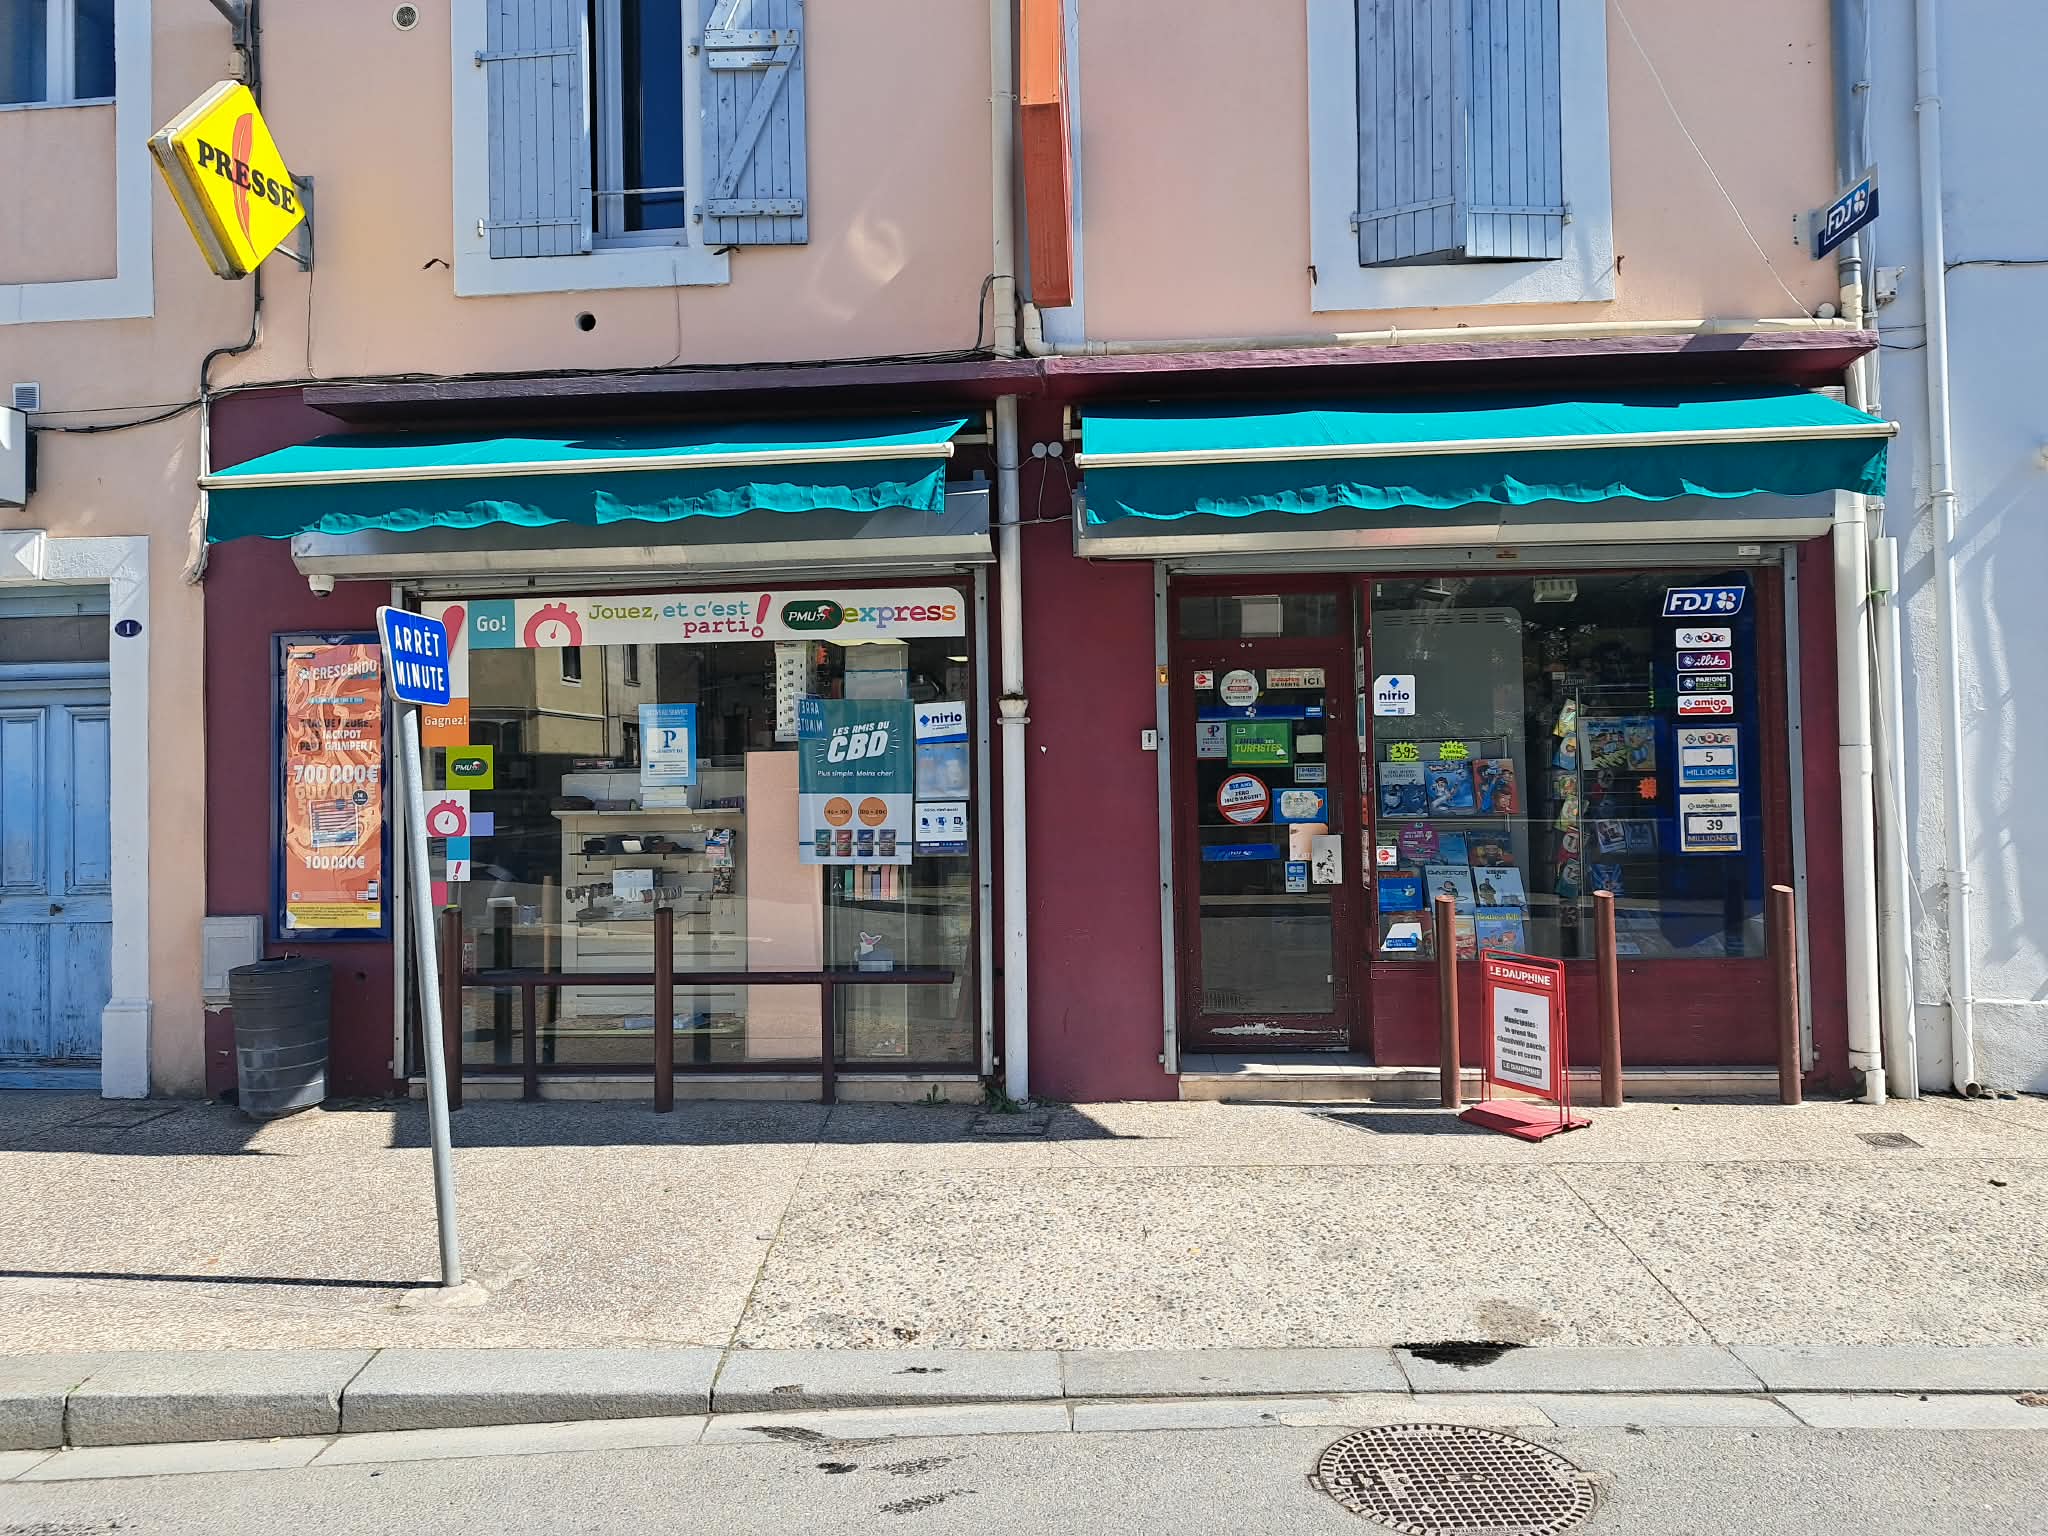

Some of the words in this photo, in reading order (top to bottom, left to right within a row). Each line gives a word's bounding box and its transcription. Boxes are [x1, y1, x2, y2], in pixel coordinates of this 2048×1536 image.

[197, 138, 296, 215] PRESSE
[1828, 198, 1853, 235] FDJ
[1669, 593, 1714, 611] FDJ
[588, 604, 659, 622] Jouez,
[663, 602, 689, 618] et
[694, 601, 751, 617] c'est
[788, 611, 816, 622] PMU
[844, 604, 957, 629] express
[126, 622, 131, 635] 1
[476, 615, 508, 632] Go!
[394, 625, 440, 658] ARRÊT
[1695, 632, 1726, 643] LOTO
[1694, 654, 1727, 667] illiko
[312, 660, 378, 681] CRESCENDO
[395, 659, 445, 692] MINUTE
[1303, 677, 1320, 686] ICI
[1379, 690, 1410, 701] nirio
[1694, 696, 1728, 711] amigo
[424, 715, 467, 728] Gagnez!
[931, 712, 962, 723] nirio
[832, 726, 849, 737] LES
[852, 722, 875, 732] AMIS
[877, 720, 890, 730] DU
[662, 730, 677, 748] P
[827, 730, 889, 764] CBD
[1705, 751, 1714, 762] 5
[1706, 820, 1723, 831] 39
[1490, 965, 1501, 976] LE
